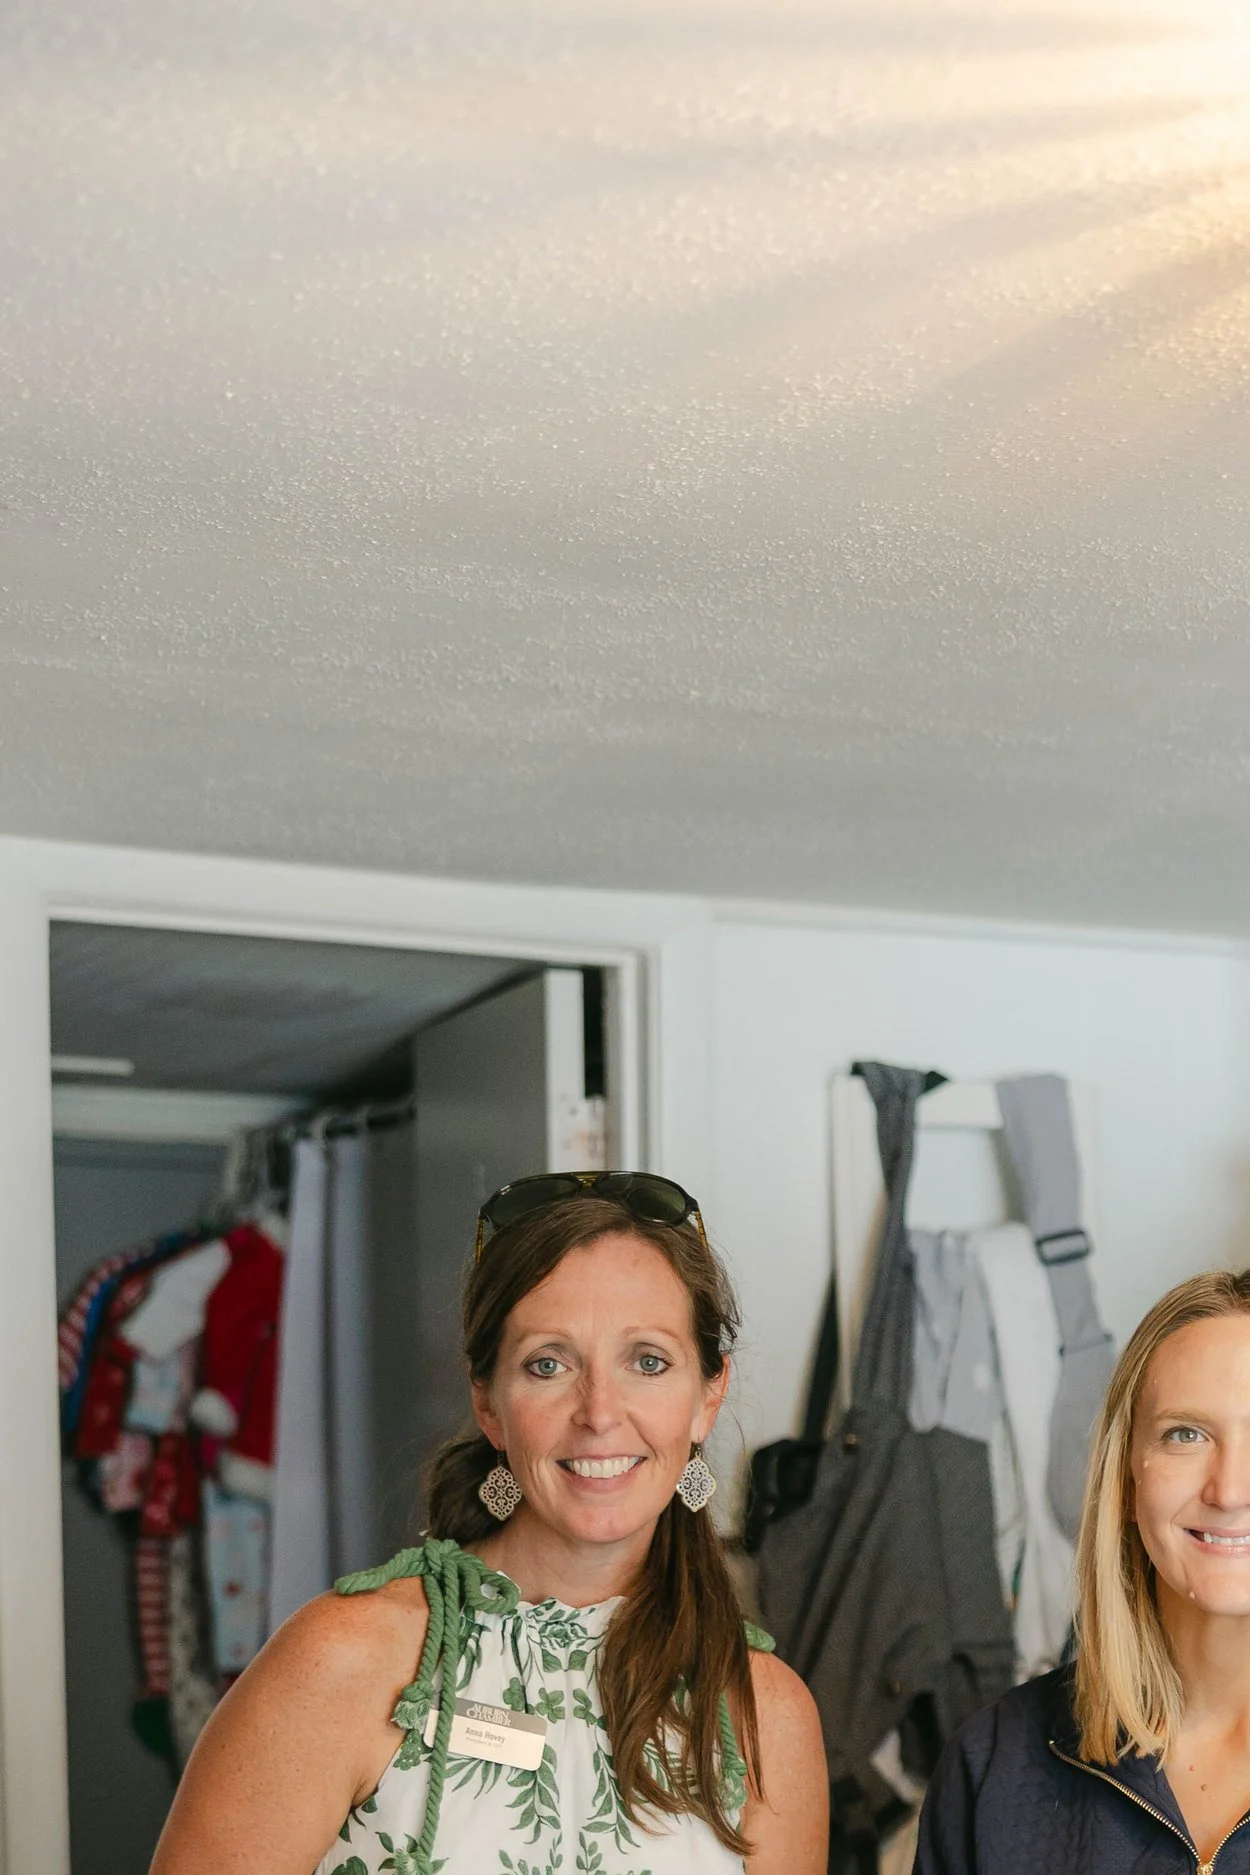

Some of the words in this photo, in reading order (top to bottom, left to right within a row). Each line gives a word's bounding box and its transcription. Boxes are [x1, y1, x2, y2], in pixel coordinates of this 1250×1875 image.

[466, 1708, 512, 1727] CHAMBER
[471, 1703, 510, 1719] AUBURN
[465, 1727, 484, 1740] Anna
